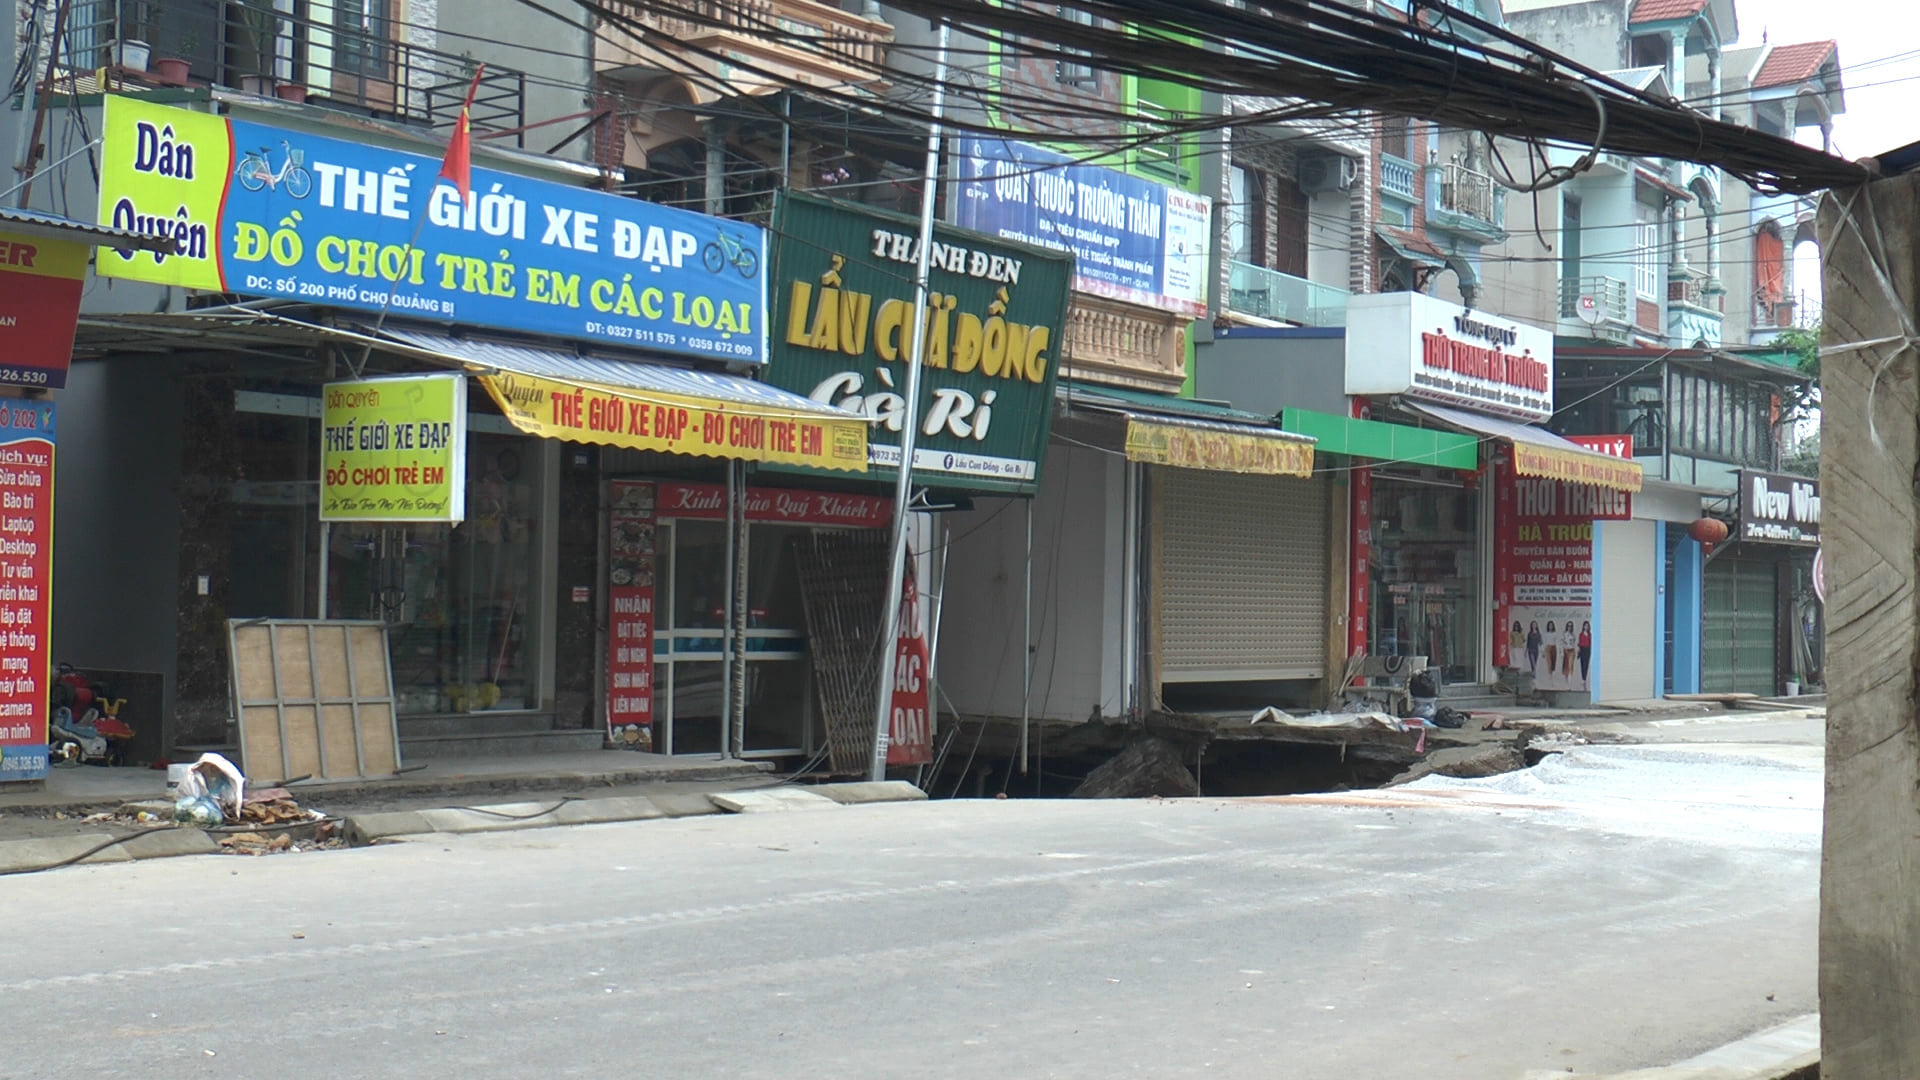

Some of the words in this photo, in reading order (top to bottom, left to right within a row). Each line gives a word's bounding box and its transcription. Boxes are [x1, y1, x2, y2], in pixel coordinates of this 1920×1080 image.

[135, 121, 194, 180] Dân
[966, 189, 989, 201] GPP
[1078, 181, 1125, 229] TRƯỜNG
[313, 162, 417, 220] THẾ
[428, 182, 526, 240] GIỚI
[542, 205, 599, 253] XE
[613, 220, 698, 272] ĐẠP
[233, 210, 304, 267] ĐỒ
[316, 236, 426, 286] CHƠI
[435, 249, 516, 298] TRẺ
[526, 267, 581, 309] EM
[590, 273, 664, 320] CÁC
[672, 292, 752, 339] LOẠI
[971, 253, 1022, 285] ĐEN
[276, 276, 297, 293] SỐ
[299, 283, 325, 297] 200
[328, 284, 357, 301] PHỐ
[360, 290, 389, 309] CHỢ
[391, 293, 440, 313] QUẢNG
[441, 302, 455, 317] BỊ
[952, 286, 1049, 384] ĐỒNG
[1454, 308, 1485, 337] TỔNG
[607, 324, 633, 338] 0327
[635, 328, 654, 342] 511
[657, 331, 676, 345] 575
[688, 336, 713, 351] 0359
[715, 339, 734, 353] 672
[735, 343, 752, 356] 009
[1422, 328, 1450, 370] THỜI
[1451, 340, 1488, 379] TRANG
[1488, 346, 1504, 383] HÀ
[1505, 349, 1548, 393] TRƯỜNG
[809, 367, 905, 431] Gà
[922, 388, 997, 441] Ri
[13, 408, 36, 429] 202
[551, 387, 584, 428] THẾ
[589, 395, 624, 434] GIỚI
[628, 402, 650, 437] XE
[654, 406, 688, 447] ĐẠP
[729, 415, 765, 450] CHƠI
[770, 413, 796, 453] TRẺ
[801, 424, 822, 457] EM
[326, 417, 357, 451] THẾ
[360, 419, 389, 450] GIỚI
[395, 423, 413, 449] XE
[419, 423, 450, 454] ĐẠP
[26, 453, 48, 467] vụ:
[326, 460, 348, 486] ĐỒ
[352, 465, 390, 485] CHƠI
[395, 461, 418, 485] TRẺ
[423, 467, 444, 484] EM
[18, 470, 41, 487] chữa
[3, 492, 22, 508] Bảo
[672, 488, 722, 509] Kính
[776, 493, 809, 517] Quý
[814, 495, 867, 518] Khách
[1563, 482, 1626, 515] TRANG
[1753, 477, 1790, 521] New
[2, 516, 34, 535] Laptop
[1518, 522, 1542, 541] HÀ
[0, 538, 36, 558] Desktop
[1, 562, 15, 578] Tư
[16, 560, 33, 579] vấn
[18, 585, 38, 601] khai
[615, 595, 651, 616] NHẬN
[10, 627, 36, 651] thống
[2, 657, 28, 674] mạng
[17, 676, 34, 694] tính
[0, 703, 32, 716] camera
[11, 723, 31, 739] ninh
